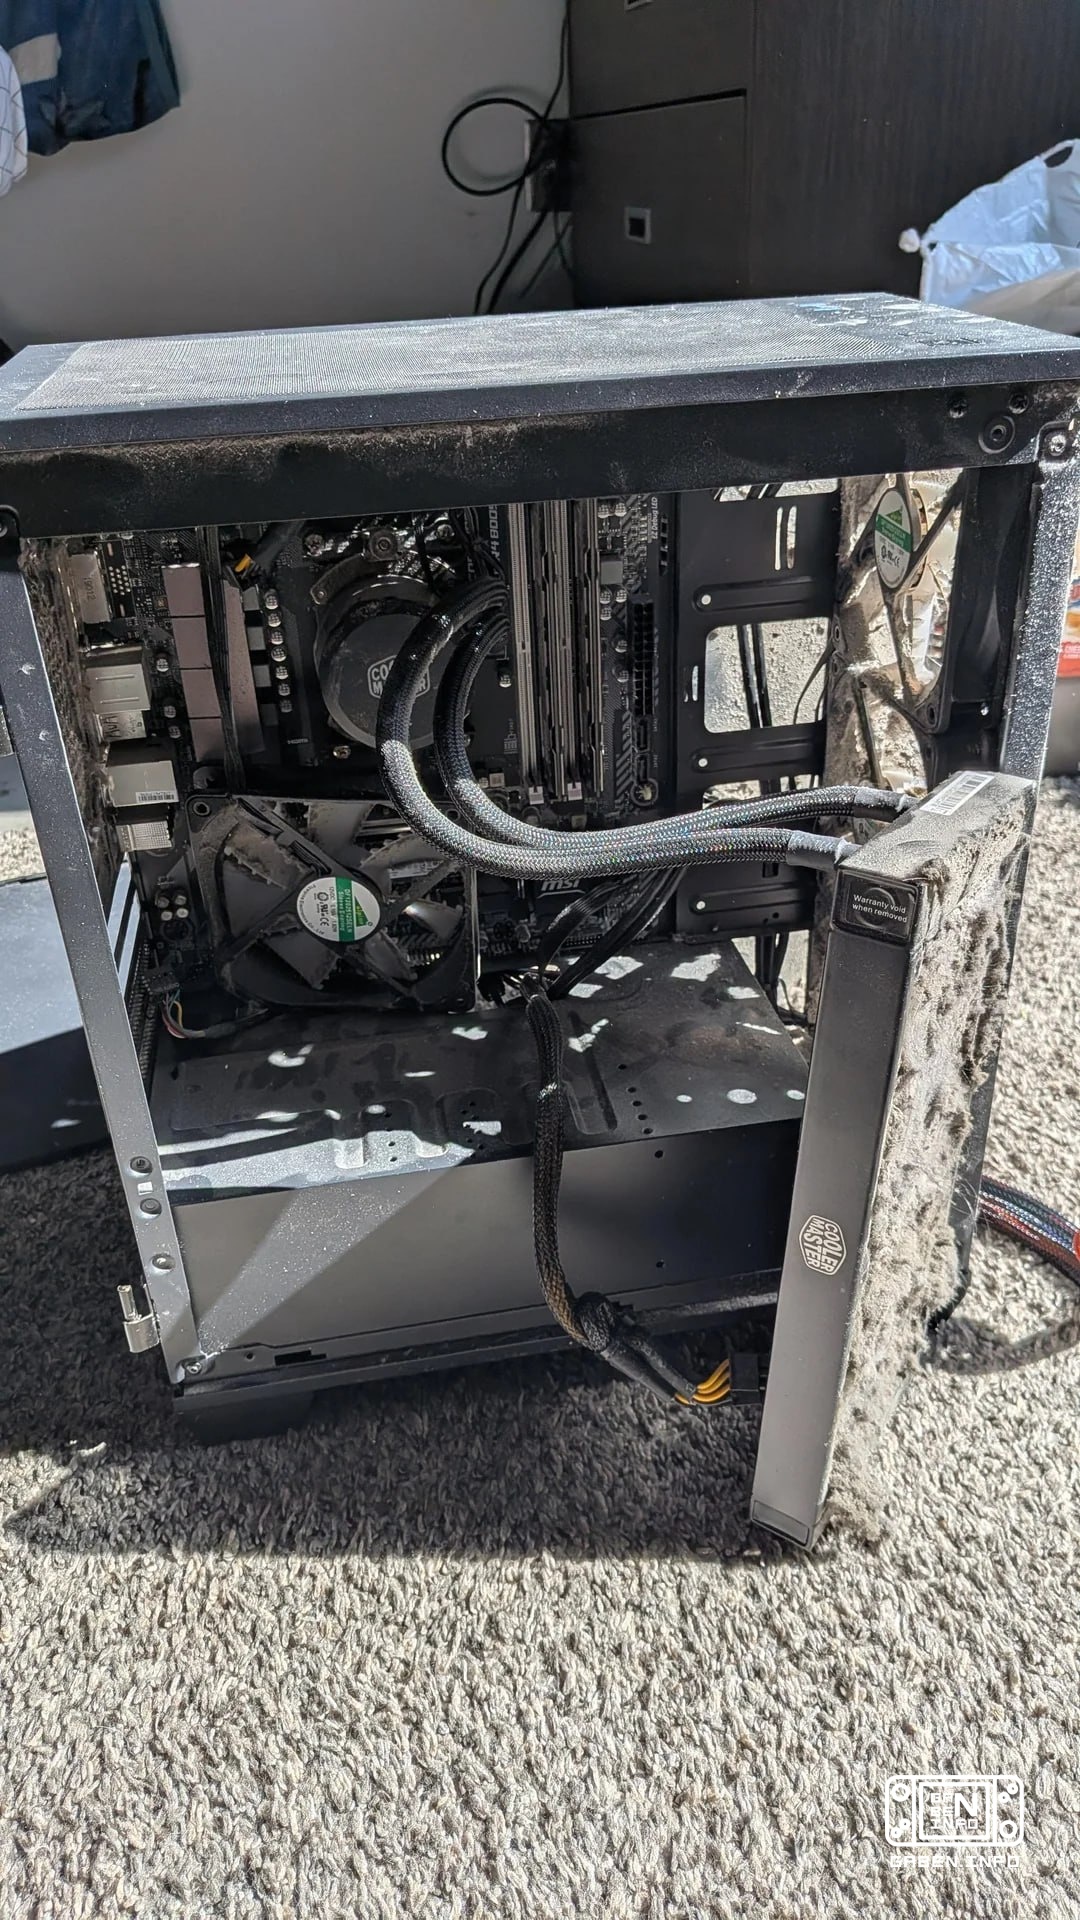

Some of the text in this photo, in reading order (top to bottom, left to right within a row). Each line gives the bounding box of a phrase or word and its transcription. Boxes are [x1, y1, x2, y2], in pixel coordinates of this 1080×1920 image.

[651, 510, 659, 531] Debug
[852, 903, 907, 923] when removed
[853, 894, 906, 914] Warranty void
[803, 1218, 825, 1268] MASTER
[821, 1223, 842, 1272] COOLER
